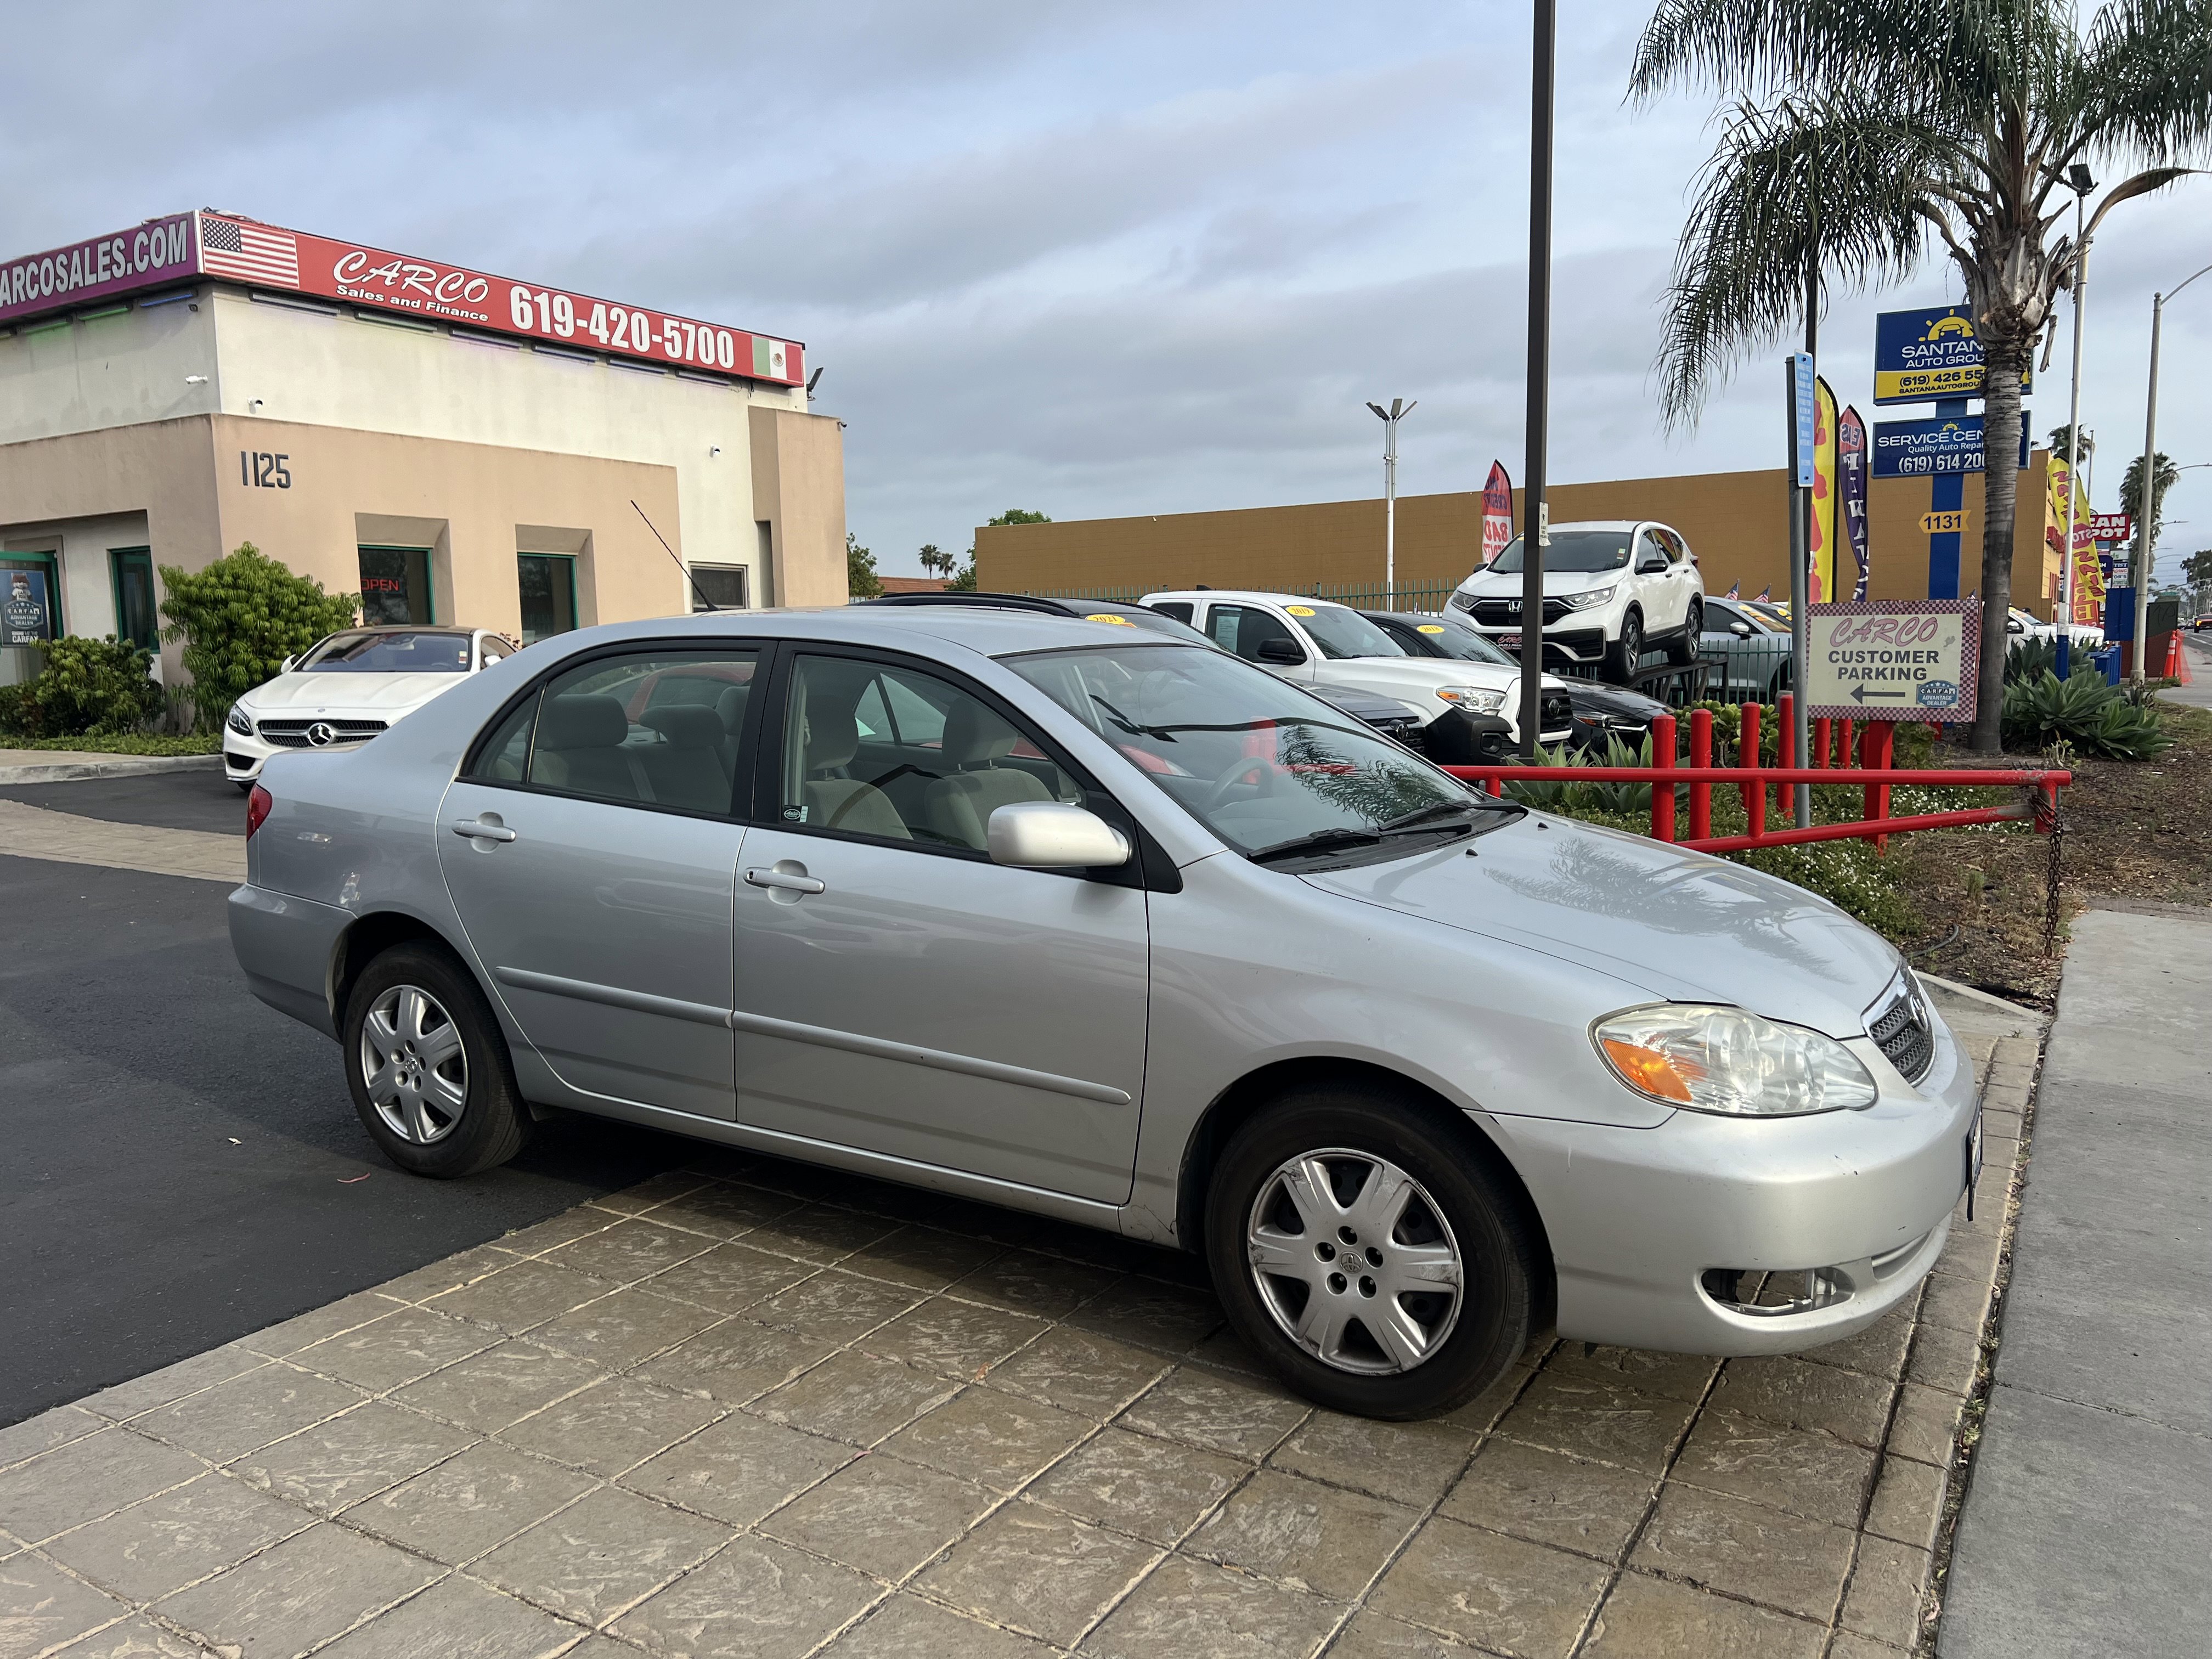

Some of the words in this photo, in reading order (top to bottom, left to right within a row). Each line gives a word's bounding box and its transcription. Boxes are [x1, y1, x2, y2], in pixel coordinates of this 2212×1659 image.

[0, 221, 187, 307] ARCOSALES.COM
[333, 251, 489, 303] CARCO
[336, 285, 384, 302] Sales
[390, 296, 421, 309] and
[426, 302, 488, 321] Finance
[510, 286, 735, 369] 619-420-5700
[1901, 340, 1985, 358] SANTAN
[1906, 358, 1943, 368] AUTO
[1946, 354, 1984, 365] GROU
[1899, 375, 1930, 387] (619)
[1933, 372, 1961, 383] 426
[1965, 369, 1983, 380] 55
[1899, 381, 1979, 394] SANTANAAUTOGROU
[1878, 432, 1950, 447] SERVICE
[1953, 430, 1983, 442] CEN
[1908, 445, 1937, 454] Quality
[1939, 443, 1959, 452] Auto
[1961, 442, 1984, 450] Repai
[241, 451, 291, 489] 1125
[1899, 455, 1932, 473] (619)
[1937, 454, 1960, 470] 614
[1963, 453, 1984, 469] 20
[1924, 515, 1961, 529] 1131
[362, 579, 399, 591] OPEN
[1830, 617, 1938, 647] CARCO
[1828, 650, 1939, 664] CUSTOMER
[1838, 667, 1927, 680] PARKING
